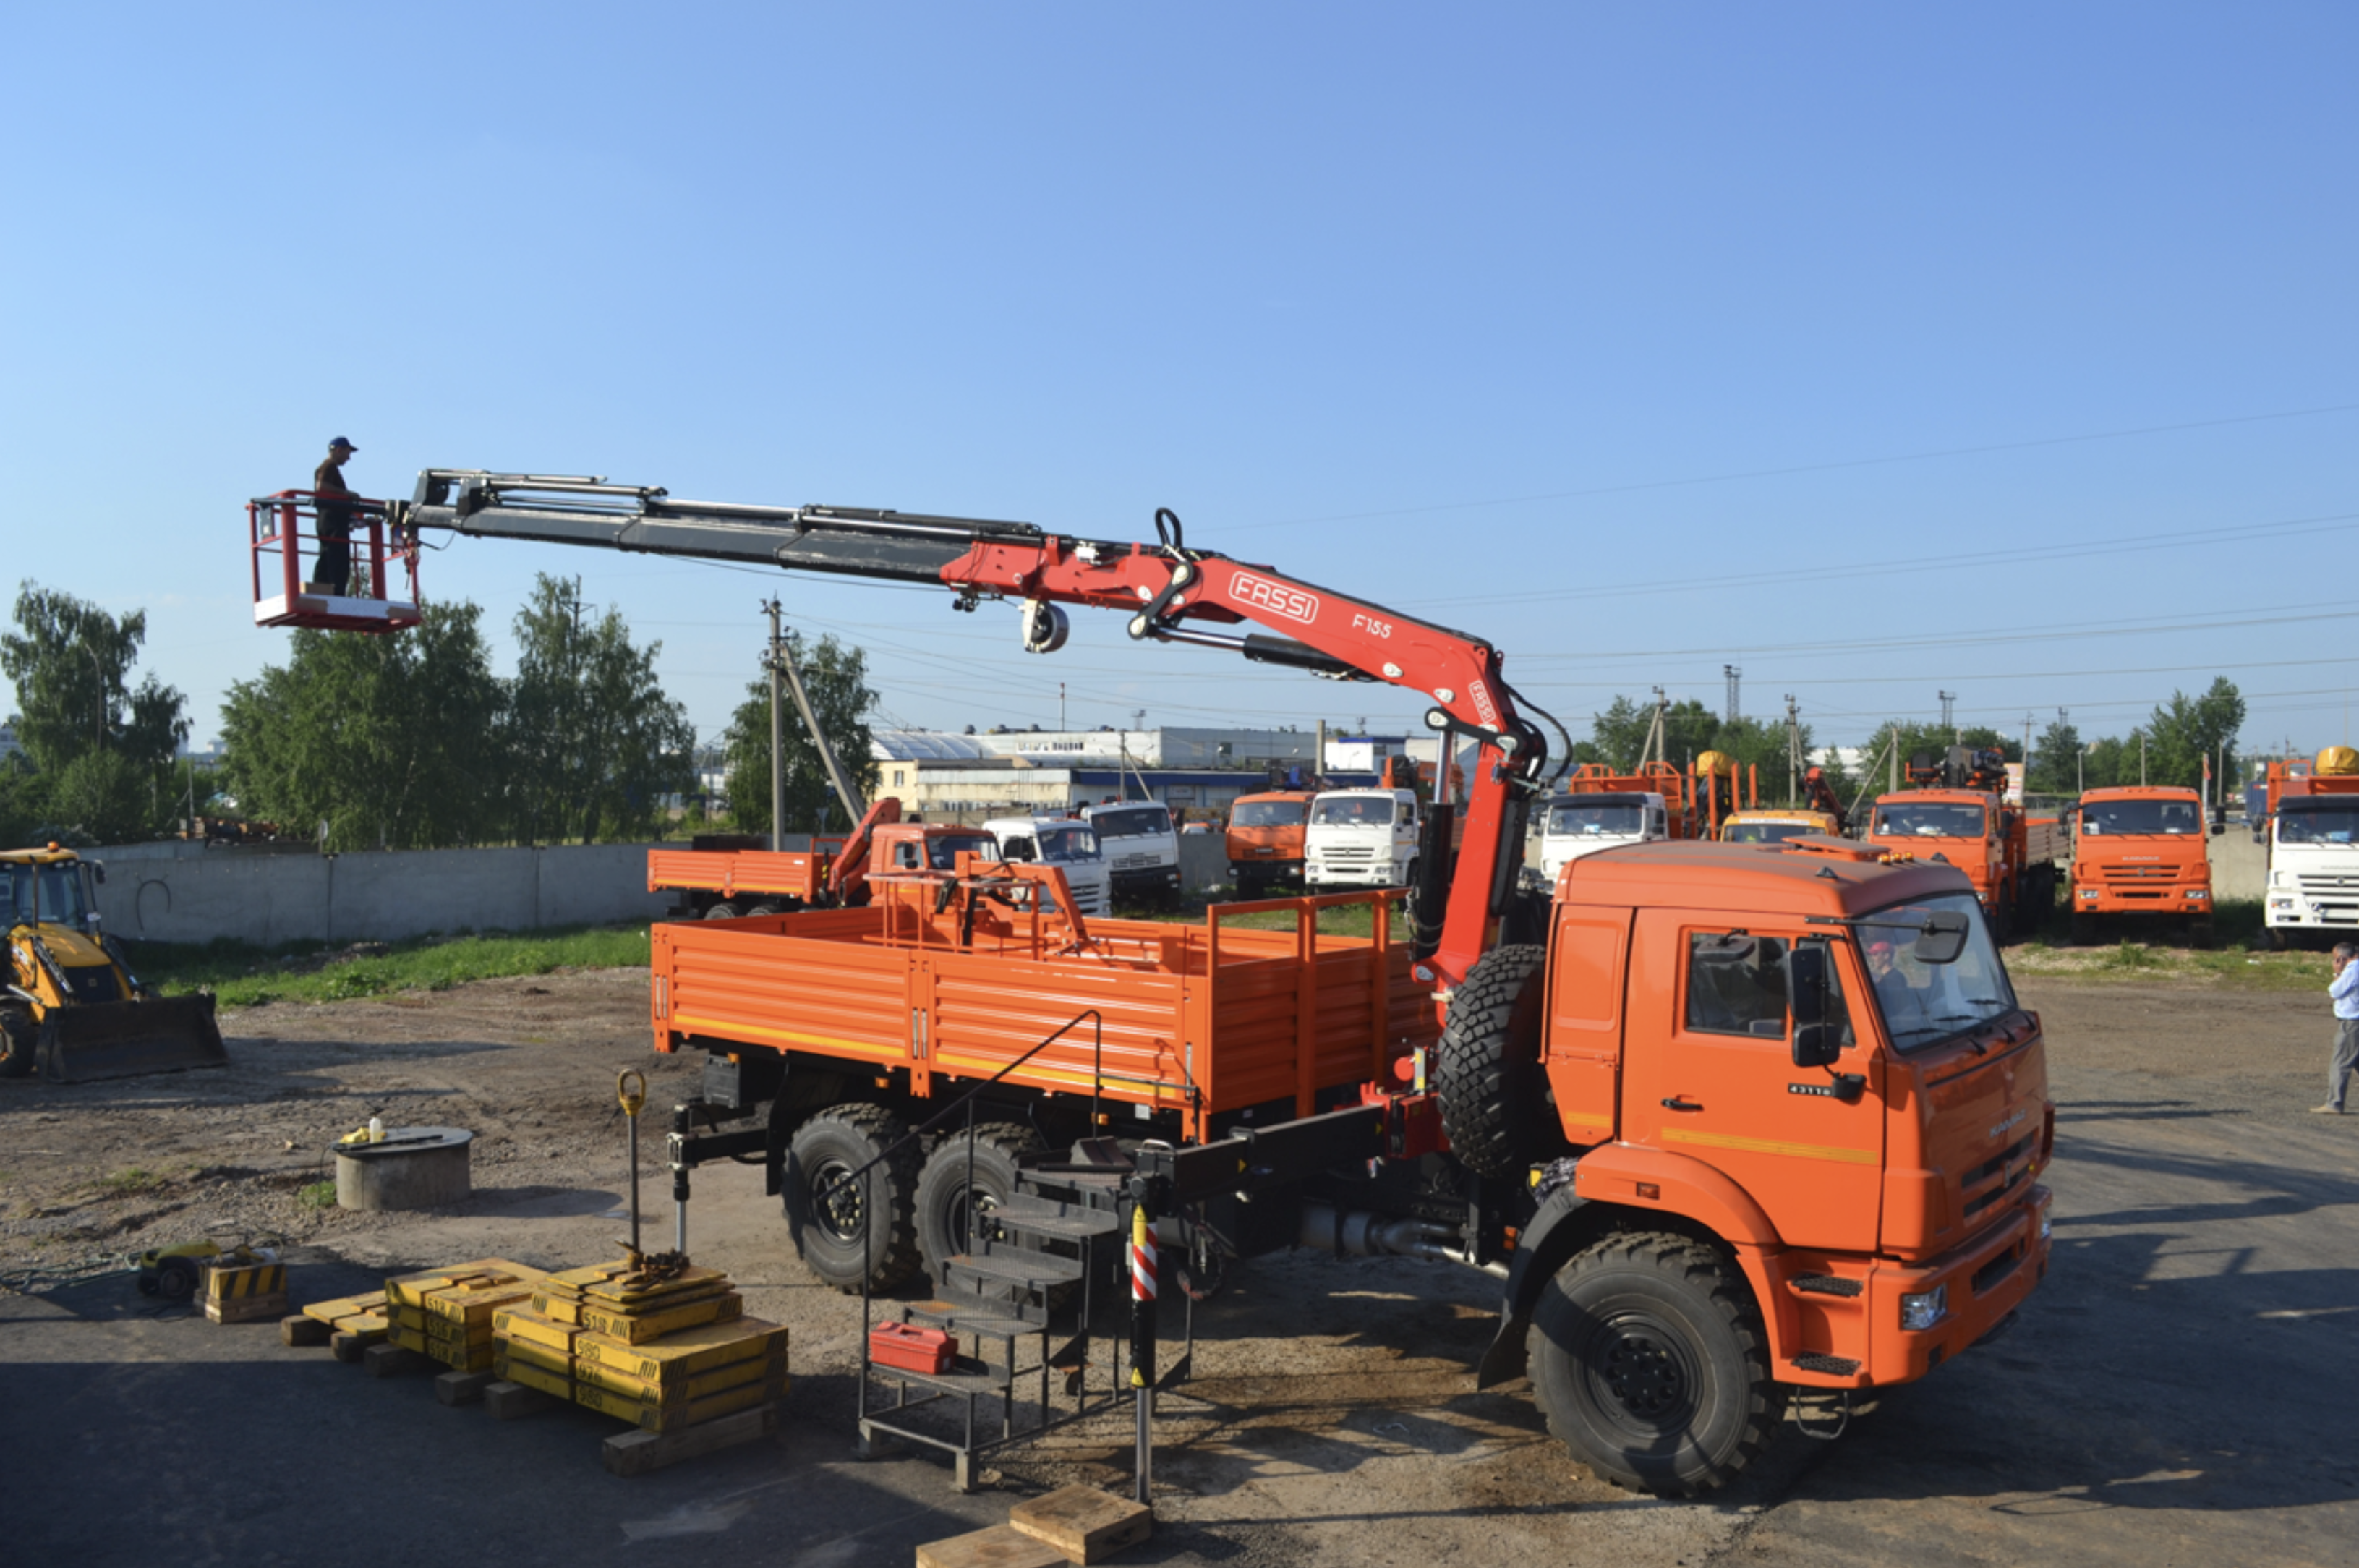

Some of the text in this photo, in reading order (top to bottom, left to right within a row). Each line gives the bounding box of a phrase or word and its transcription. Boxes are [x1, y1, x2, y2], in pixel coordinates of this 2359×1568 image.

[1235, 577, 1313, 620] FASSI
[1352, 613, 1392, 639] F155
[1472, 683, 1494, 719] FASSI
